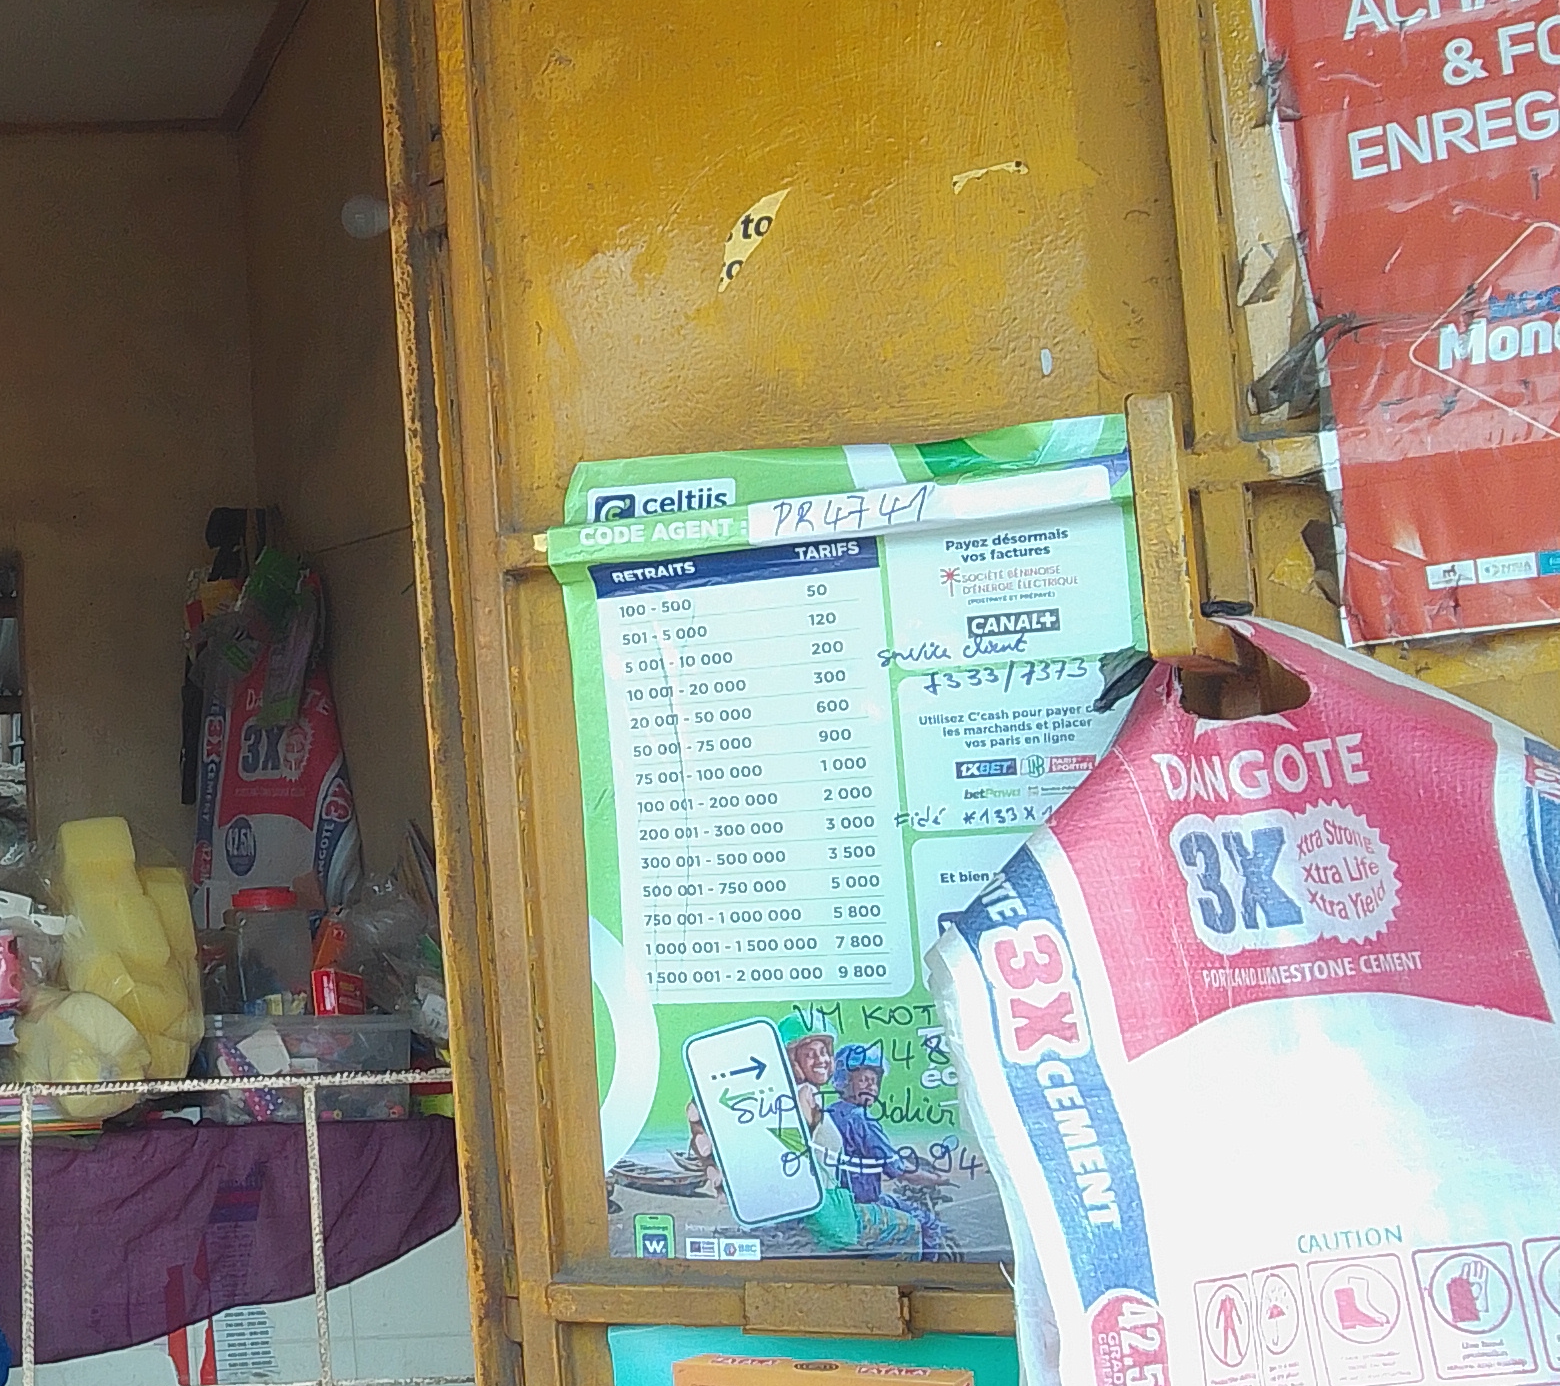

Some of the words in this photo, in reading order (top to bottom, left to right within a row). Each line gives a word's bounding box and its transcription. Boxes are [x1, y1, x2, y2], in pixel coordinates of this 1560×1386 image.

[1443, 38, 1489, 86] &
[1439, 318, 1560, 370] Mon
[642, 487, 727, 513] celtiis
[580, 525, 644, 546] CODE
[945, 538, 988, 551] Payez
[992, 529, 1068, 546] désormais
[612, 562, 695, 583] RETRAITS
[795, 541, 860, 560] TARIFS
[961, 552, 986, 563] vos
[990, 546, 1050, 560] factures
[619, 604, 645, 618] 100
[661, 599, 691, 612] 500
[806, 584, 827, 597] 50
[622, 633, 648, 645] 501
[677, 626, 707, 639] 000
[809, 612, 836, 626] 120
[971, 612, 1056, 634] CANAL+
[639, 658, 664, 671] 001
[680, 656, 695, 668] 10
[701, 652, 733, 665] 000
[811, 641, 843, 655] 200
[627, 689, 643, 701] 10
[649, 686, 673, 698] 001
[690, 682, 708, 695] 20
[714, 679, 746, 692] 000
[814, 670, 846, 683] 300
[630, 717, 649, 729] 20
[655, 714, 678, 726] 001
[695, 712, 714, 723] 50
[720, 708, 751, 721] 000
[817, 699, 849, 713] 600
[919, 714, 964, 726] Utilisez
[969, 711, 1009, 722] C'cash
[1013, 709, 1043, 721] pour
[1046, 706, 1081, 717] payer
[943, 726, 960, 737] les
[964, 721, 1032, 735] marchands
[1036, 720, 1049, 730] et
[1053, 719, 1092, 729] placer
[633, 745, 653, 757] 50
[659, 742, 681, 755] 001
[697, 740, 715, 752] 75
[720, 737, 752, 750] 000
[819, 729, 851, 742] 900
[965, 739, 986, 748] vos
[991, 736, 1020, 746] paris
[1025, 735, 1040, 744] en
[1044, 733, 1075, 744] ligne
[636, 773, 653, 785] 75
[658, 771, 683, 783] 001
[696, 768, 724, 781] 100
[730, 765, 762, 778] 000
[833, 757, 866, 771] 000
[1150, 733, 1370, 803] DANGOTE
[941, 873, 956, 883] Et
[960, 870, 989, 882] bien
[1180, 827, 1304, 934] 3X
[1343, 856, 1380, 882] Life
[1348, 882, 1386, 919] Yield
[1360, 951, 1422, 973] CEMENT
[994, 934, 1079, 1051] 3X
[1038, 1061, 1122, 1227] CEMENT
[1298, 1225, 1402, 1253] CAUTION
